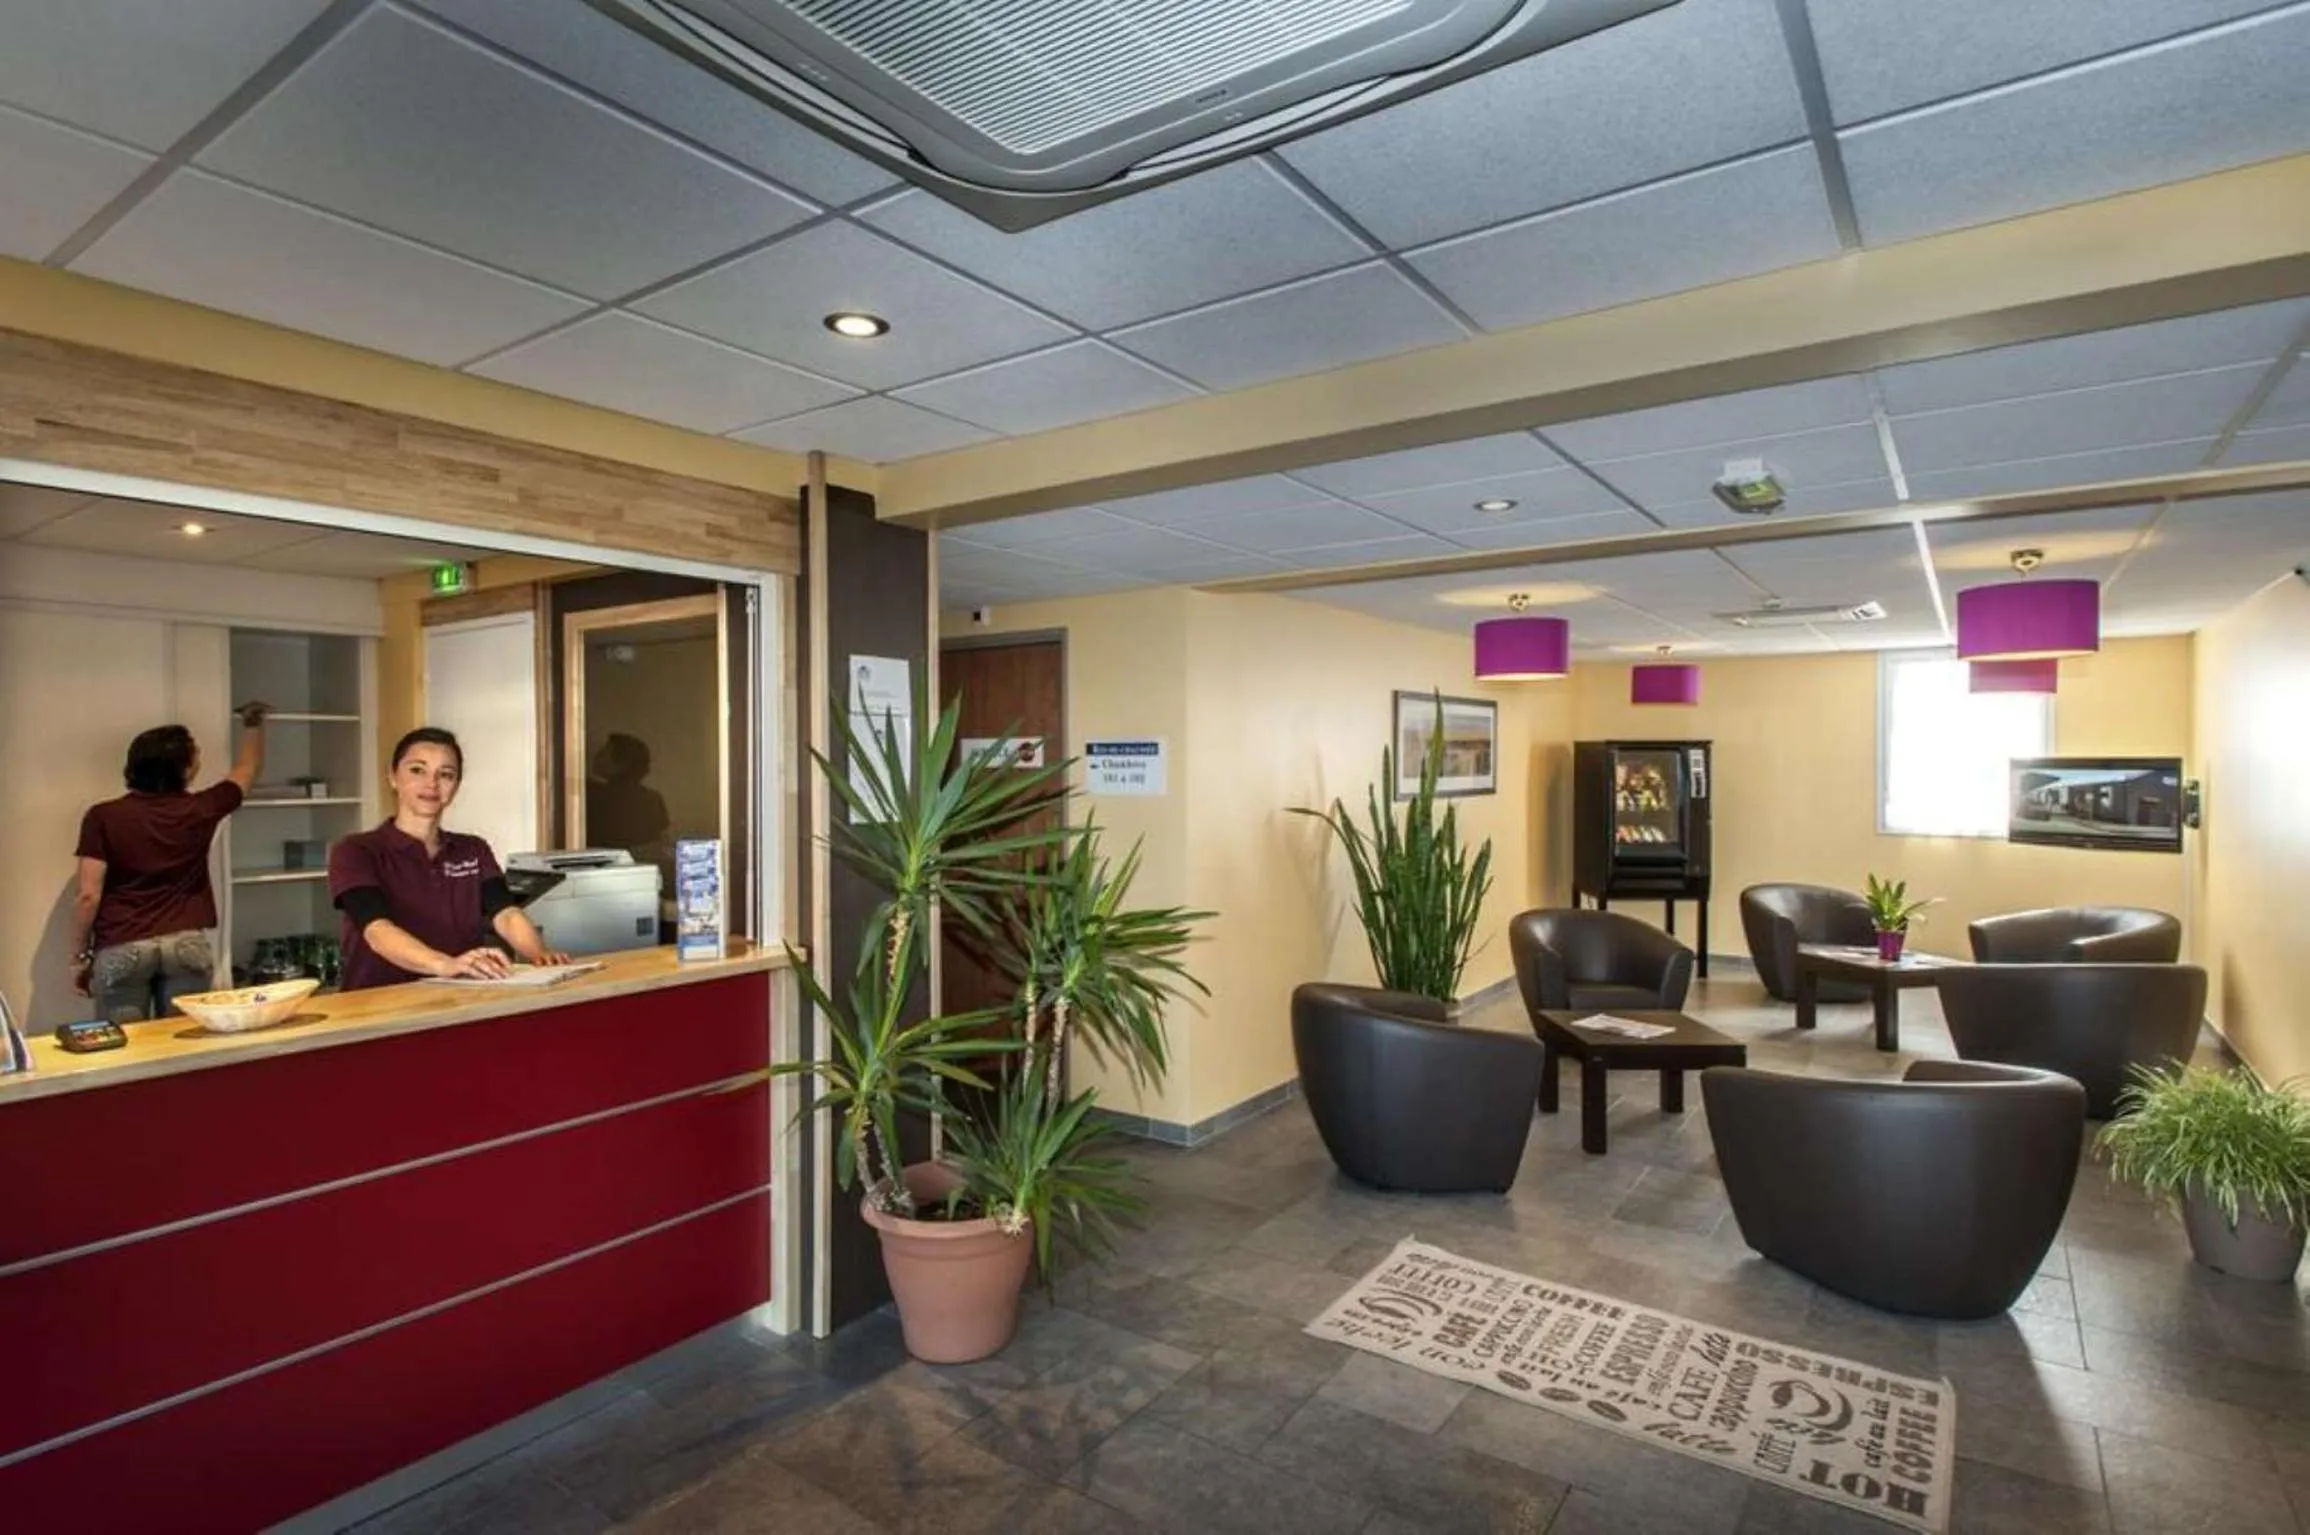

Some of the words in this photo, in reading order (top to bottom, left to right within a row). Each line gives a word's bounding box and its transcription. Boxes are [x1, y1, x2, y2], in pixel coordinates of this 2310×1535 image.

[1522, 1284, 1626, 1320] COFFEE
[1537, 1314, 1584, 1355] FRESH
[1573, 1322, 1616, 1368] COFFEE
[1600, 1315, 1668, 1385] ESPRESSO
[1683, 1331, 1731, 1368] latte
[1736, 1342, 1939, 1407] ESPRESSO
[1890, 1407, 1936, 1484] COFFEE
[1799, 1459, 1929, 1518] HOT
